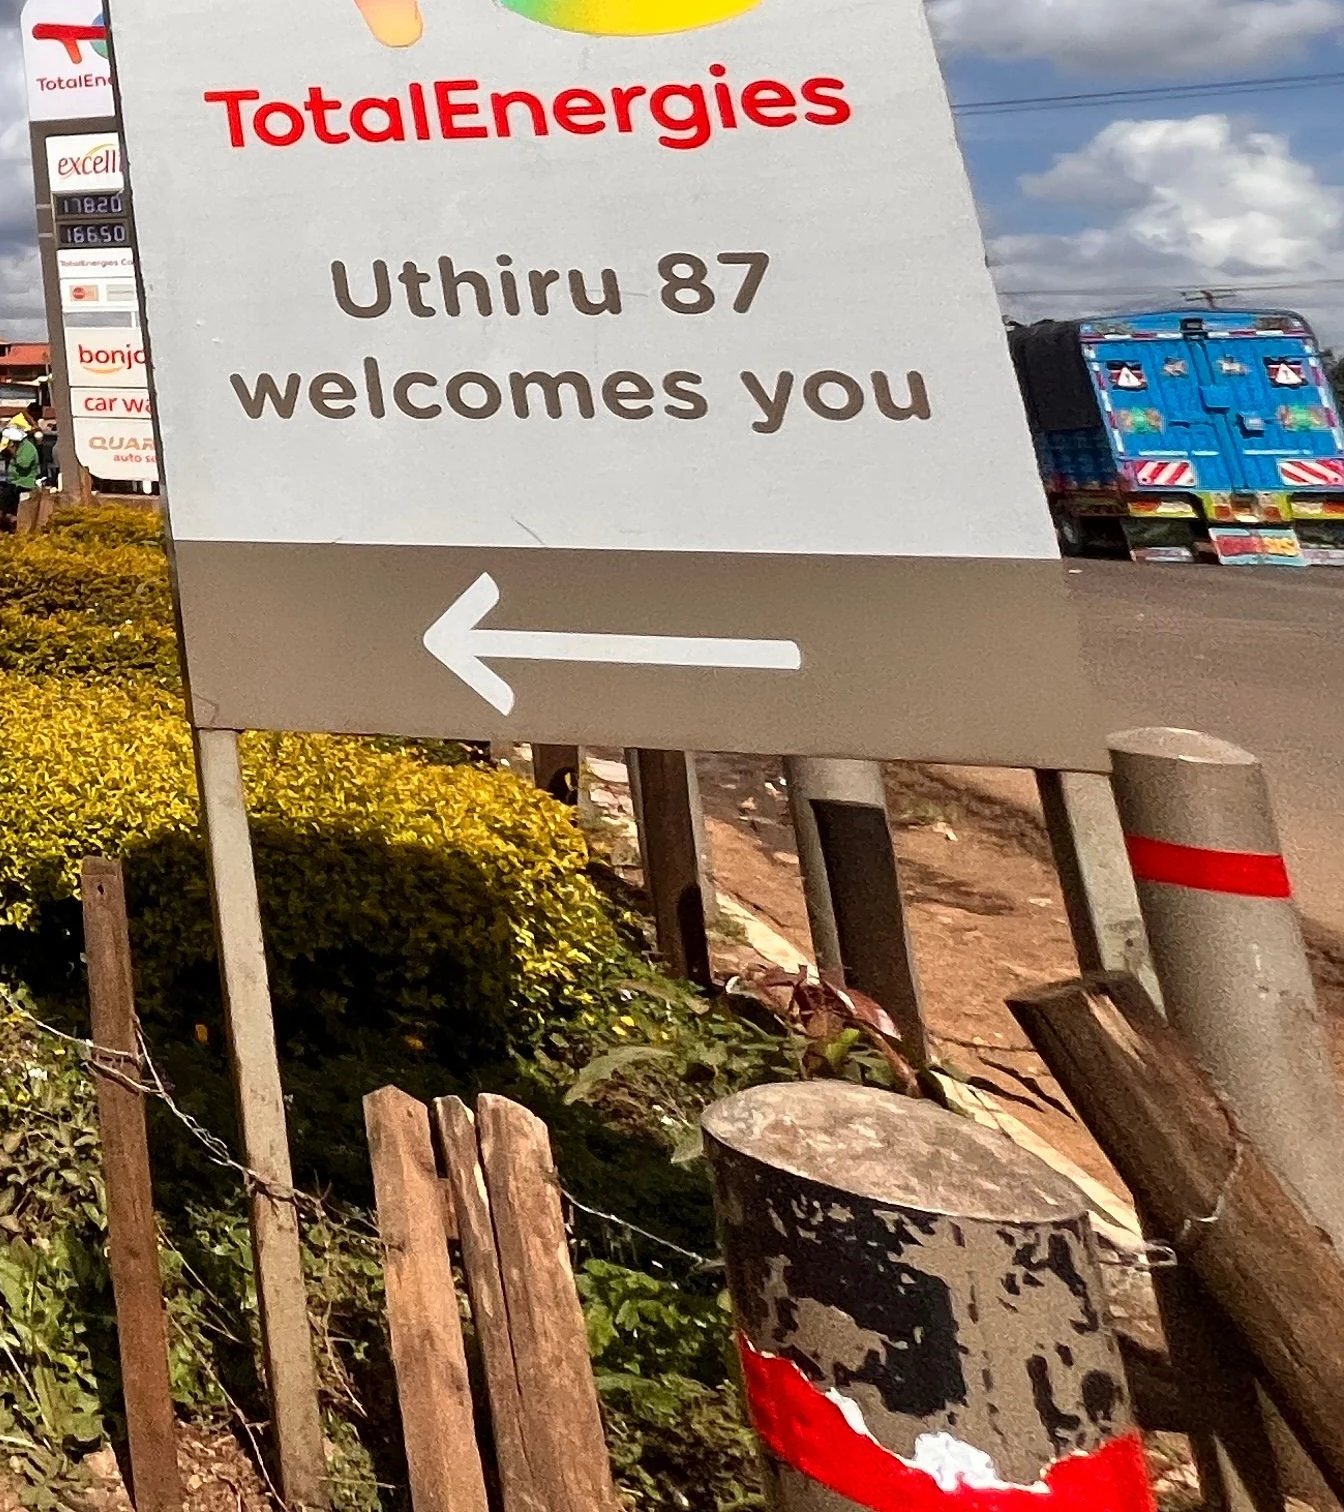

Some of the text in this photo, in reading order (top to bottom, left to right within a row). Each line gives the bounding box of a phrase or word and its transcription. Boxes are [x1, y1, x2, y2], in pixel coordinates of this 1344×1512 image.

[204, 64, 851, 149] TotalEnergies
[330, 252, 770, 318] Uthiru 87
[84, 396, 118, 412] car
[230, 356, 932, 434] welcomes you
[113, 454, 142, 463] auto
